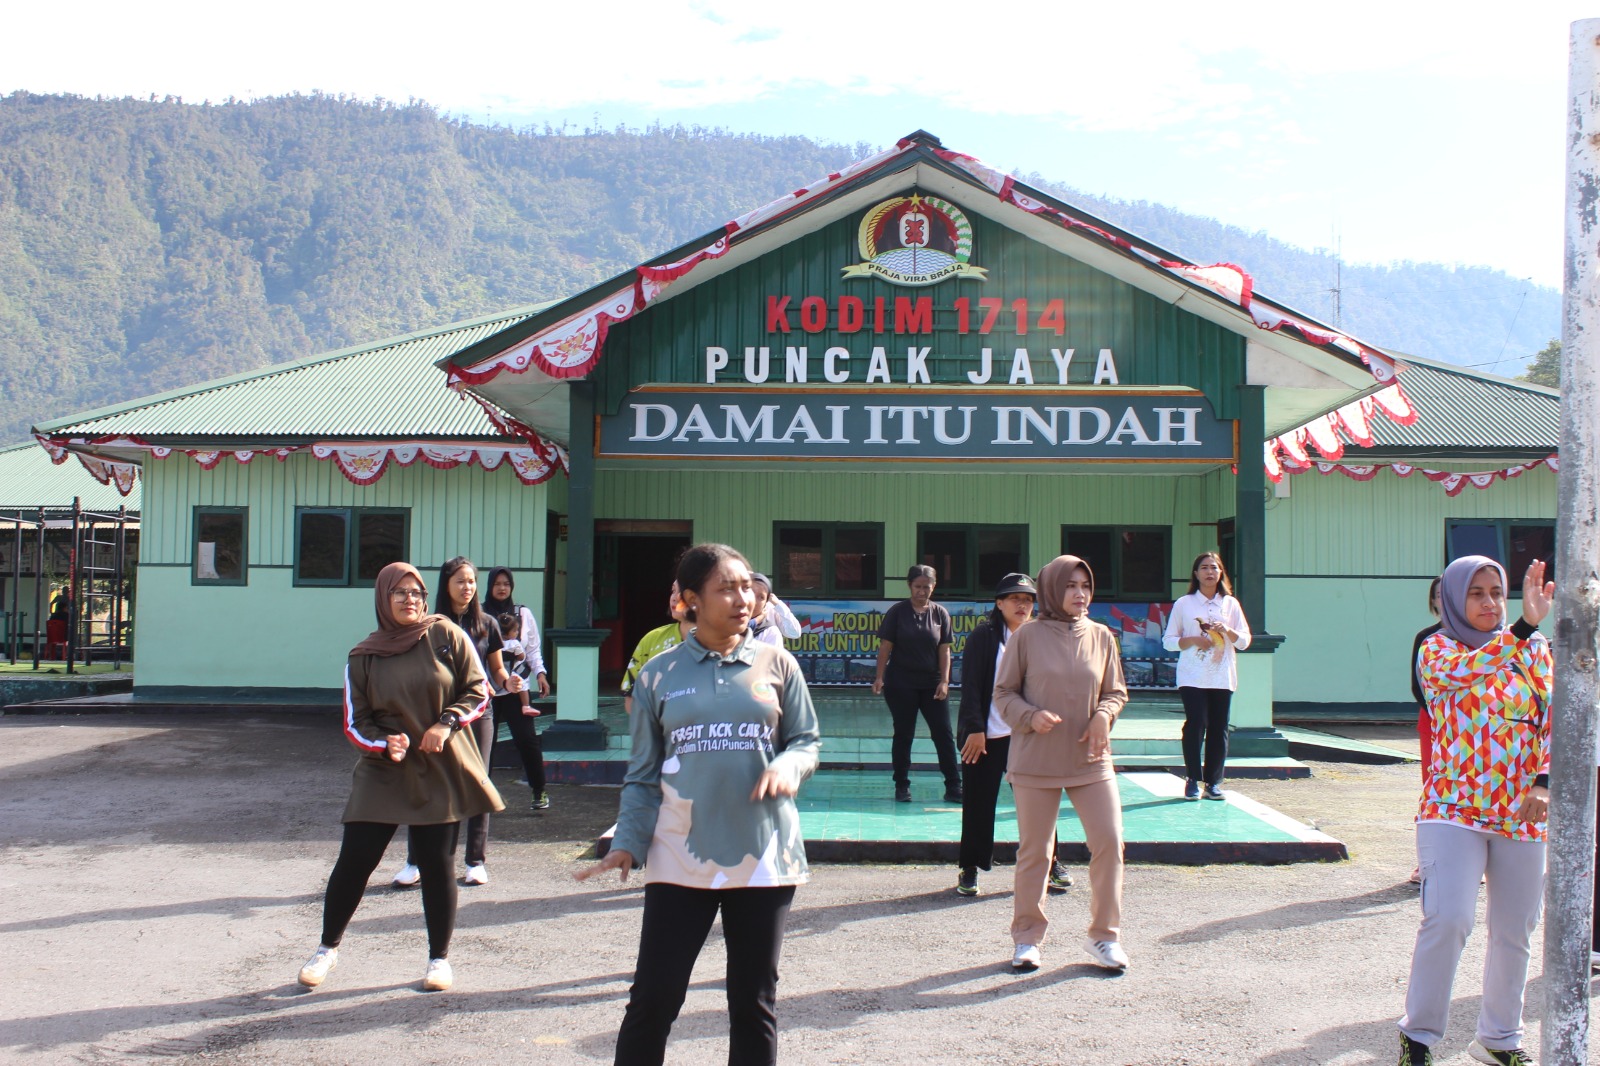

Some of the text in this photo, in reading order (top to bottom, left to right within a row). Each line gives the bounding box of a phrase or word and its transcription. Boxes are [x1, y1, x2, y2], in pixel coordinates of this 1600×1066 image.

[867, 263, 901, 281] PRAJA
[930, 263, 964, 280] BRAJA
[767, 295, 1066, 336] KODIM 1714
[706, 346, 1119, 385] PUNCAK JAYA
[629, 403, 1203, 446] DAMAI ITU INDAH
[824, 633, 881, 652] UNTUK
[708, 723, 733, 738] KCK
[738, 723, 760, 738] CAB
